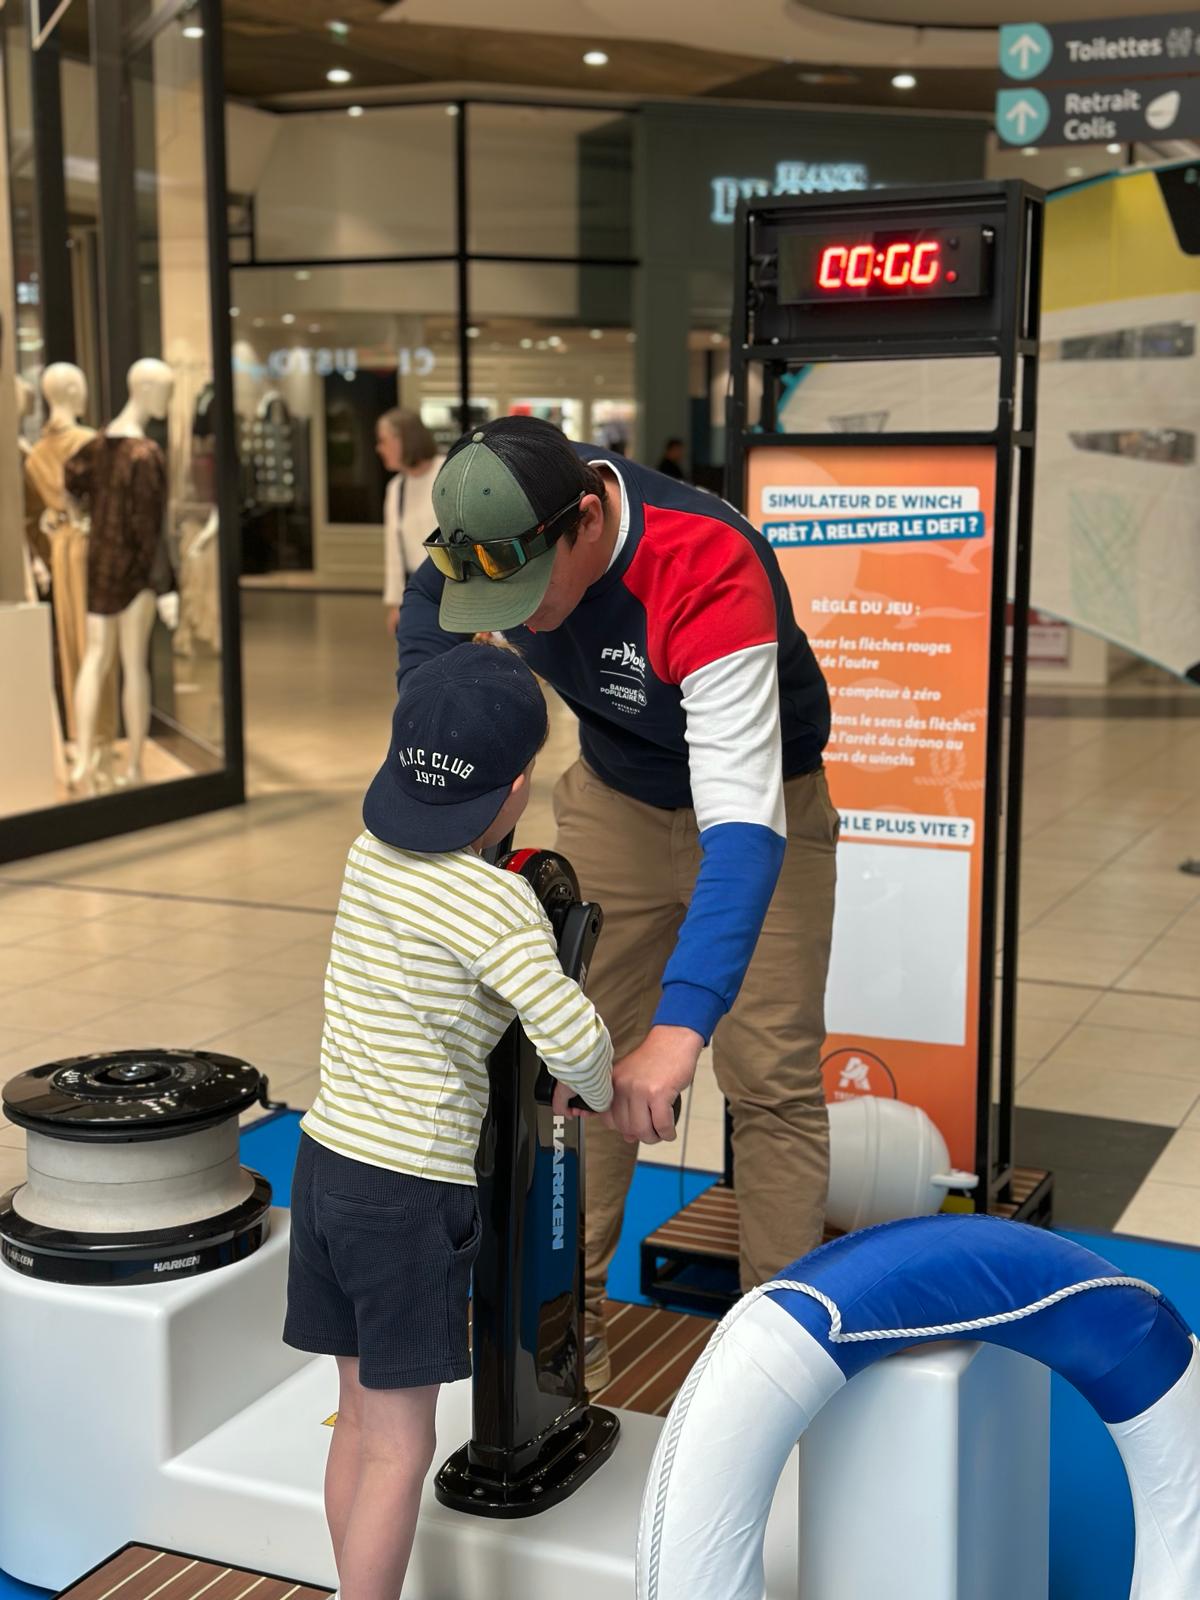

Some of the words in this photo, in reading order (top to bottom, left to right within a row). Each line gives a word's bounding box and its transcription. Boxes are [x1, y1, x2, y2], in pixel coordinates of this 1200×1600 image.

[1065, 36, 1162, 62] Toilettes
[1064, 88, 1141, 114] Retrait
[1063, 117, 1117, 141] Colis
[769, 494, 870, 508] SIMULATEUR
[875, 495, 897, 508] DE
[902, 495, 962, 509] WINCH
[810, 521, 824, 541] À
[826, 521, 899, 540] RELEVER
[902, 520, 924, 536] LE
[927, 518, 965, 535] DEFI
[969, 517, 979, 533] ?
[811, 597, 857, 614] RÈGLE
[861, 600, 882, 614] DU
[885, 602, 912, 615] JEU
[840, 636, 857, 651] les
[859, 637, 904, 652] flèches
[907, 641, 952, 656] rouges
[820, 654, 836, 668] de
[600, 687, 638, 702] POPULAIRE
[609, 683, 637, 696] BANQUE
[839, 685, 899, 701] compteur
[913, 687, 941, 701] zéro
[860, 713, 871, 728] le
[874, 718, 901, 729] sens
[904, 716, 926, 730] des
[929, 716, 976, 732] flèches
[879, 733, 895, 747] du
[898, 736, 943, 750] chrono
[945, 740, 964, 751] au
[431, 752, 475, 780] CLUB
[851, 750, 867, 764] de
[869, 753, 915, 767] winchs
[414, 769, 446, 787] 1973
[853, 818, 872, 831] LE
[876, 819, 916, 834] PLUS
[920, 822, 957, 837] VITE
[962, 824, 970, 838] ?
[552, 1115, 565, 1250] HARKEN
[153, 1255, 201, 1273] HARKEN
